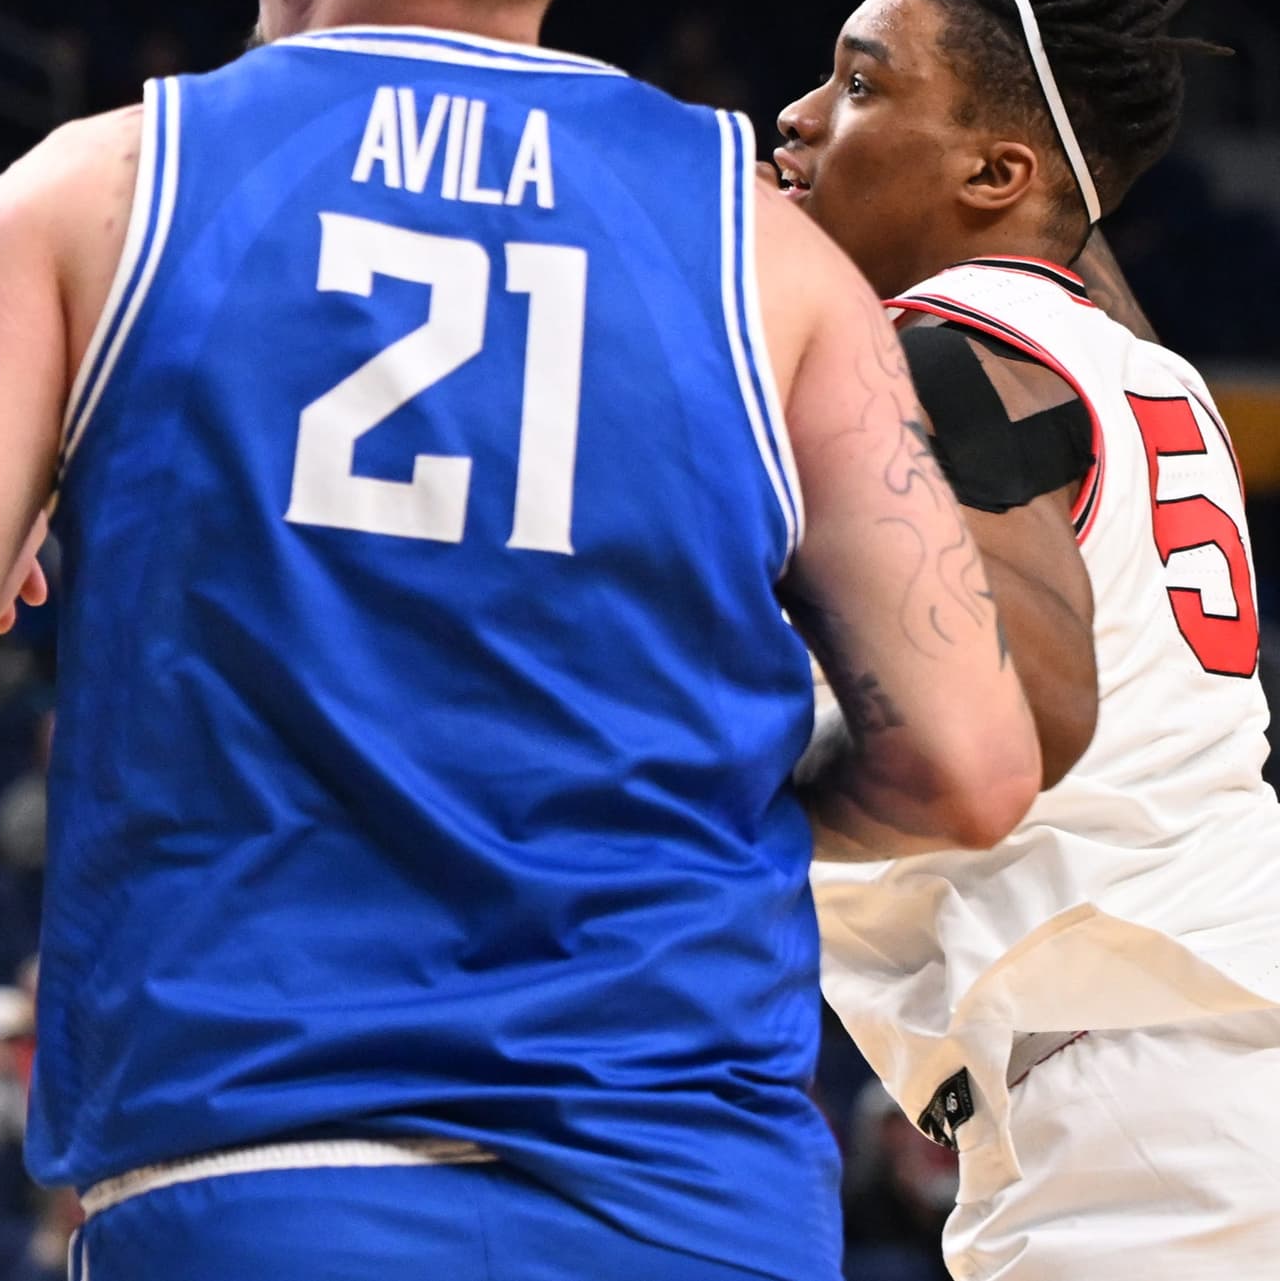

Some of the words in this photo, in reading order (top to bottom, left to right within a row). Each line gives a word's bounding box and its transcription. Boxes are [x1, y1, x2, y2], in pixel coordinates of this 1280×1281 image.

[351, 86, 554, 209] AVILA
[284, 212, 587, 555] 21
[1125, 390, 1259, 678] 5
